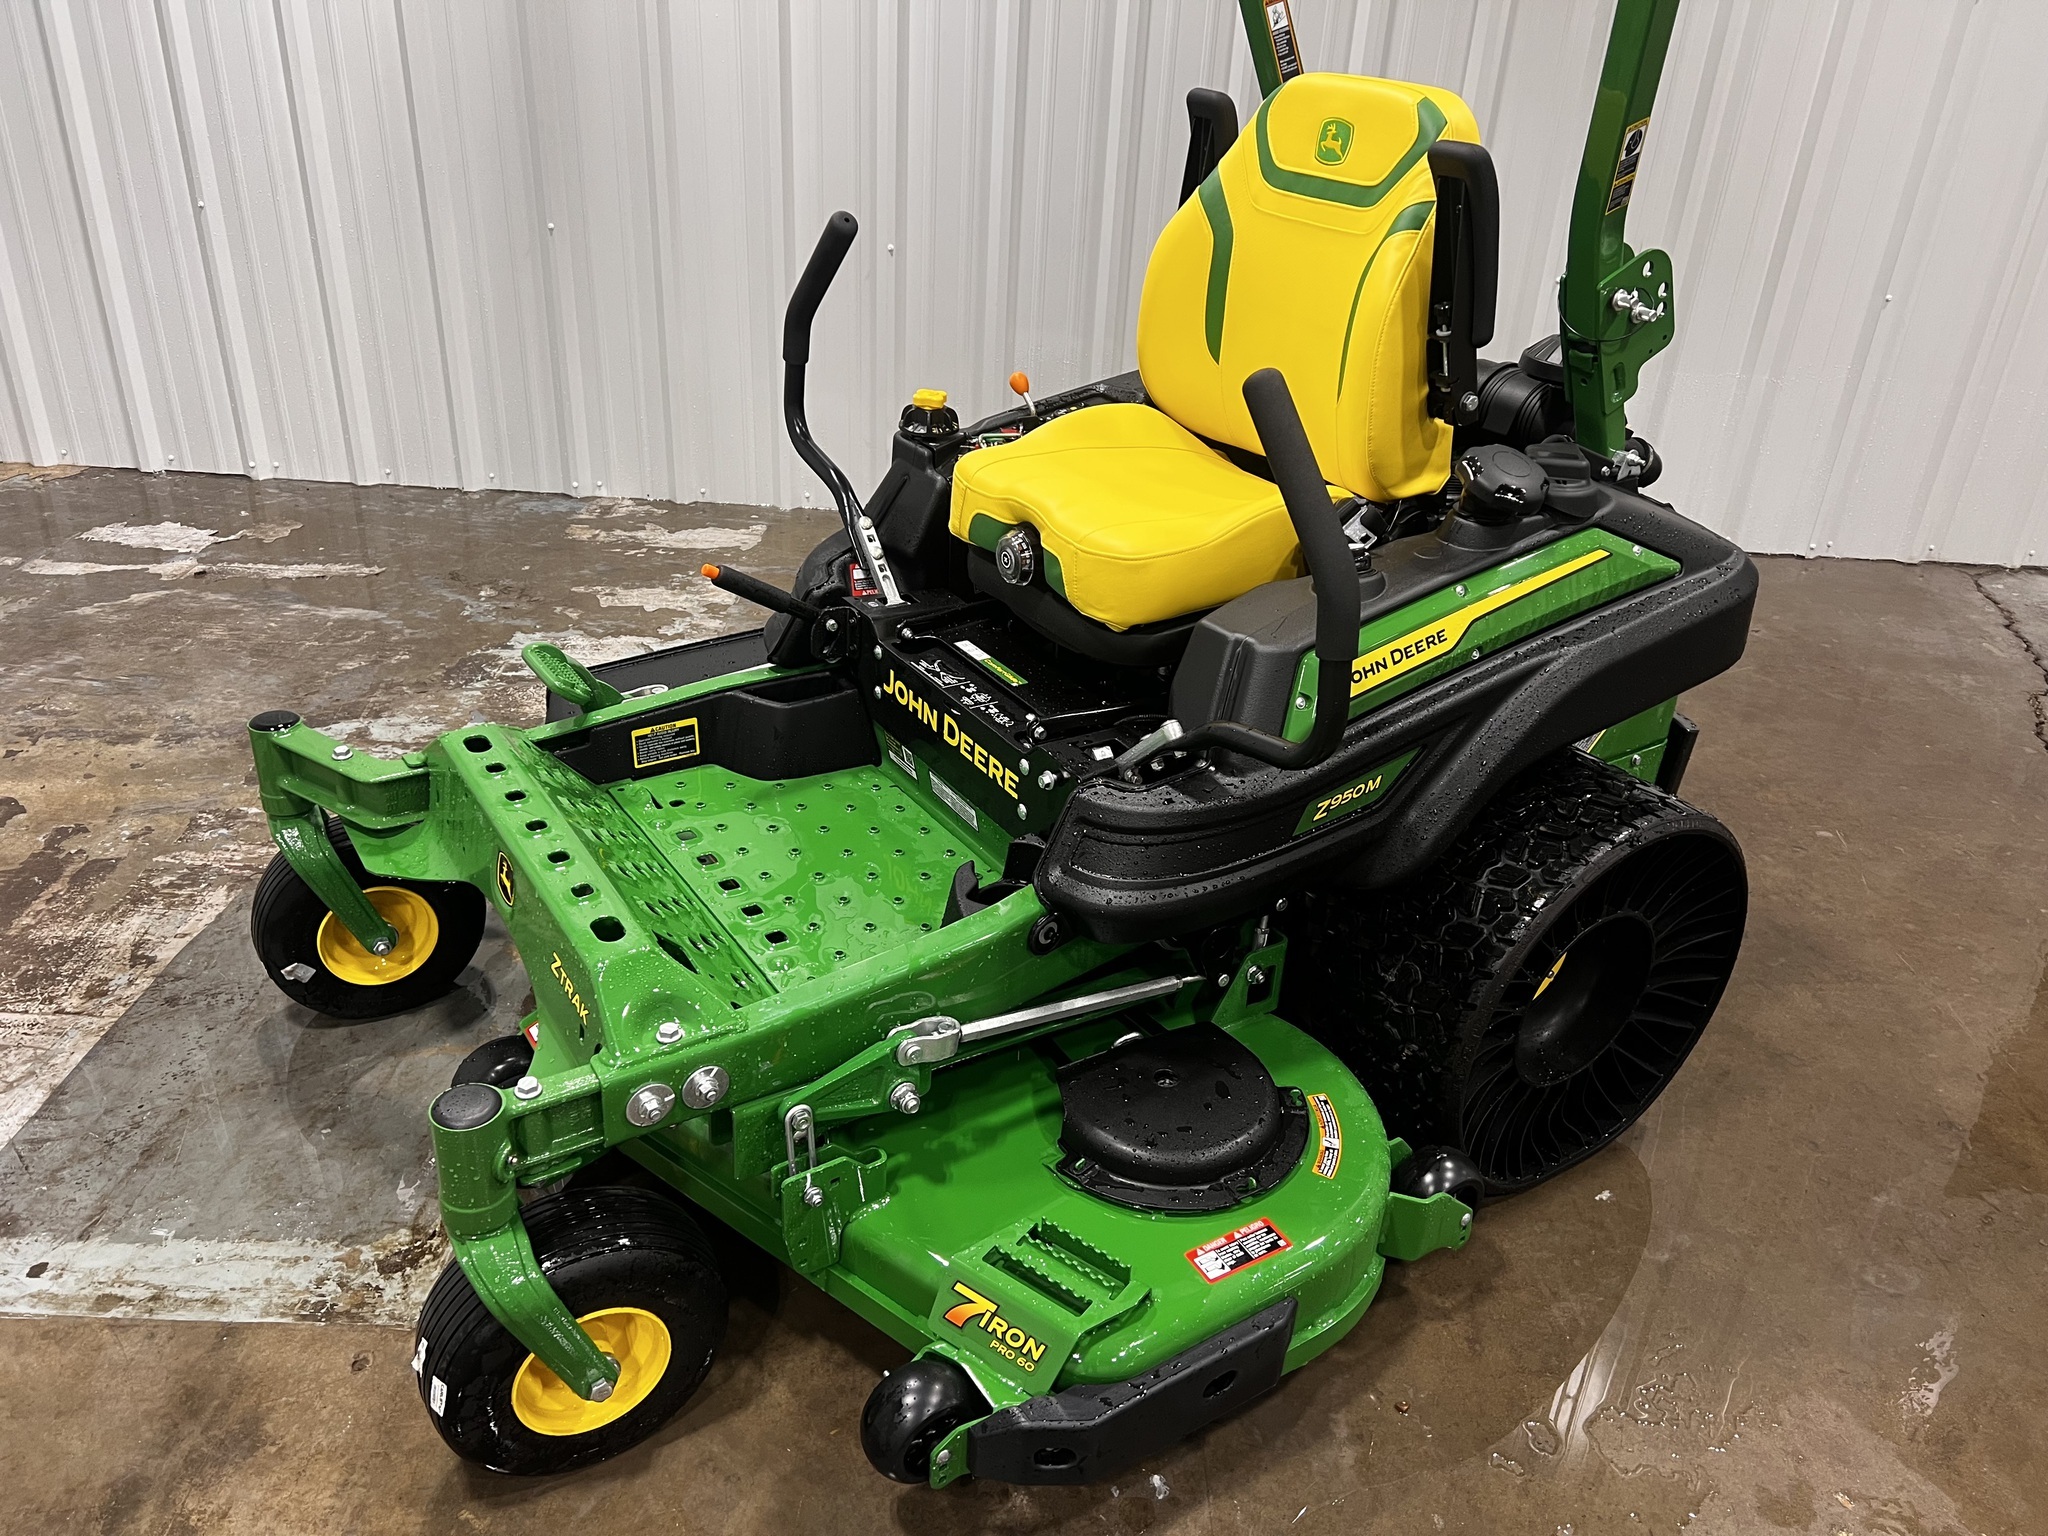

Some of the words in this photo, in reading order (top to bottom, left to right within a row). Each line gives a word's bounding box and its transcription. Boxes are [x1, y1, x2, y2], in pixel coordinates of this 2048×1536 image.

[1351, 660, 1388, 684] OHN
[1390, 628, 1448, 666] DEERE
[654, 723, 677, 731] CAUTION
[883, 669, 938, 733] JOHN
[943, 712, 1019, 800] DEERE
[1312, 774, 1383, 822] Z950M
[551, 951, 589, 1026] ZTRAK
[1202, 1237, 1228, 1252] DANGER
[1239, 1220, 1265, 1236] PELIGRO
[989, 1340, 1016, 1360] PRO
[1016, 1357, 1035, 1372] 60
